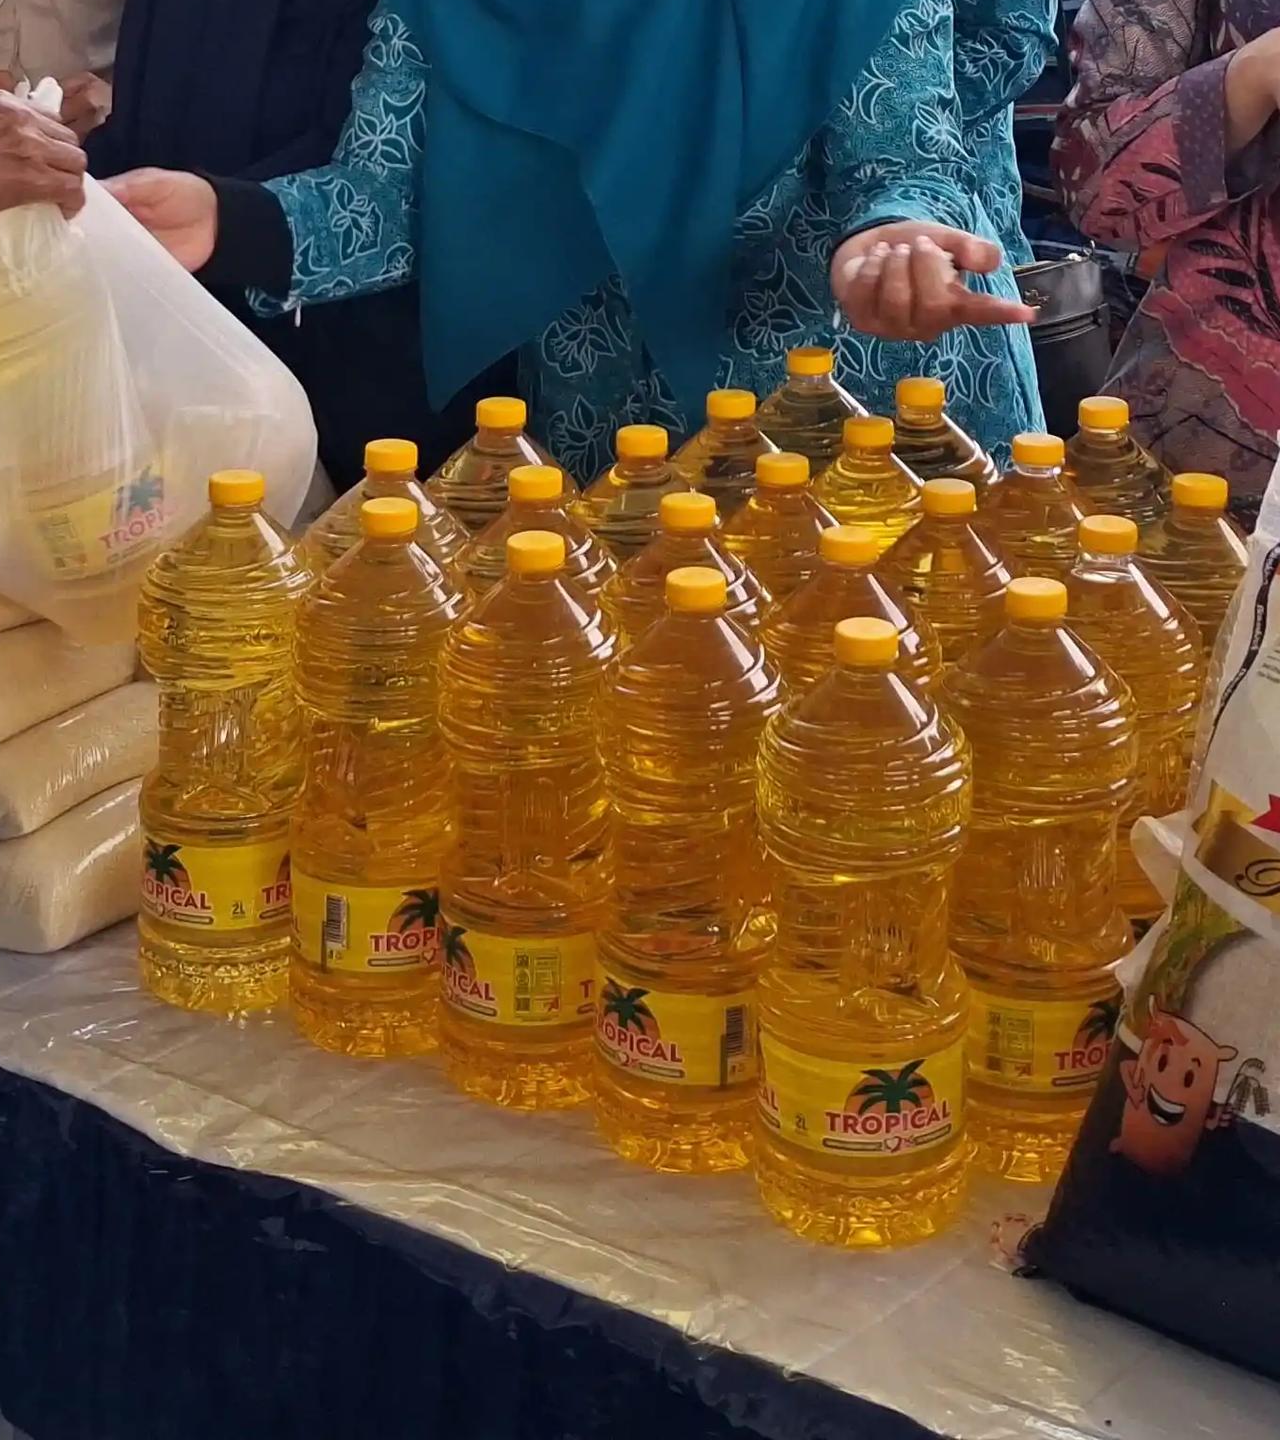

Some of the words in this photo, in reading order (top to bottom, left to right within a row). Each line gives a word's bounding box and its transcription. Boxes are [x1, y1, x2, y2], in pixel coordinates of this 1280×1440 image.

[144, 877, 212, 911] OPICAL
[370, 927, 442, 953] TROPI
[825, 1100, 952, 1137] TROPICAL
